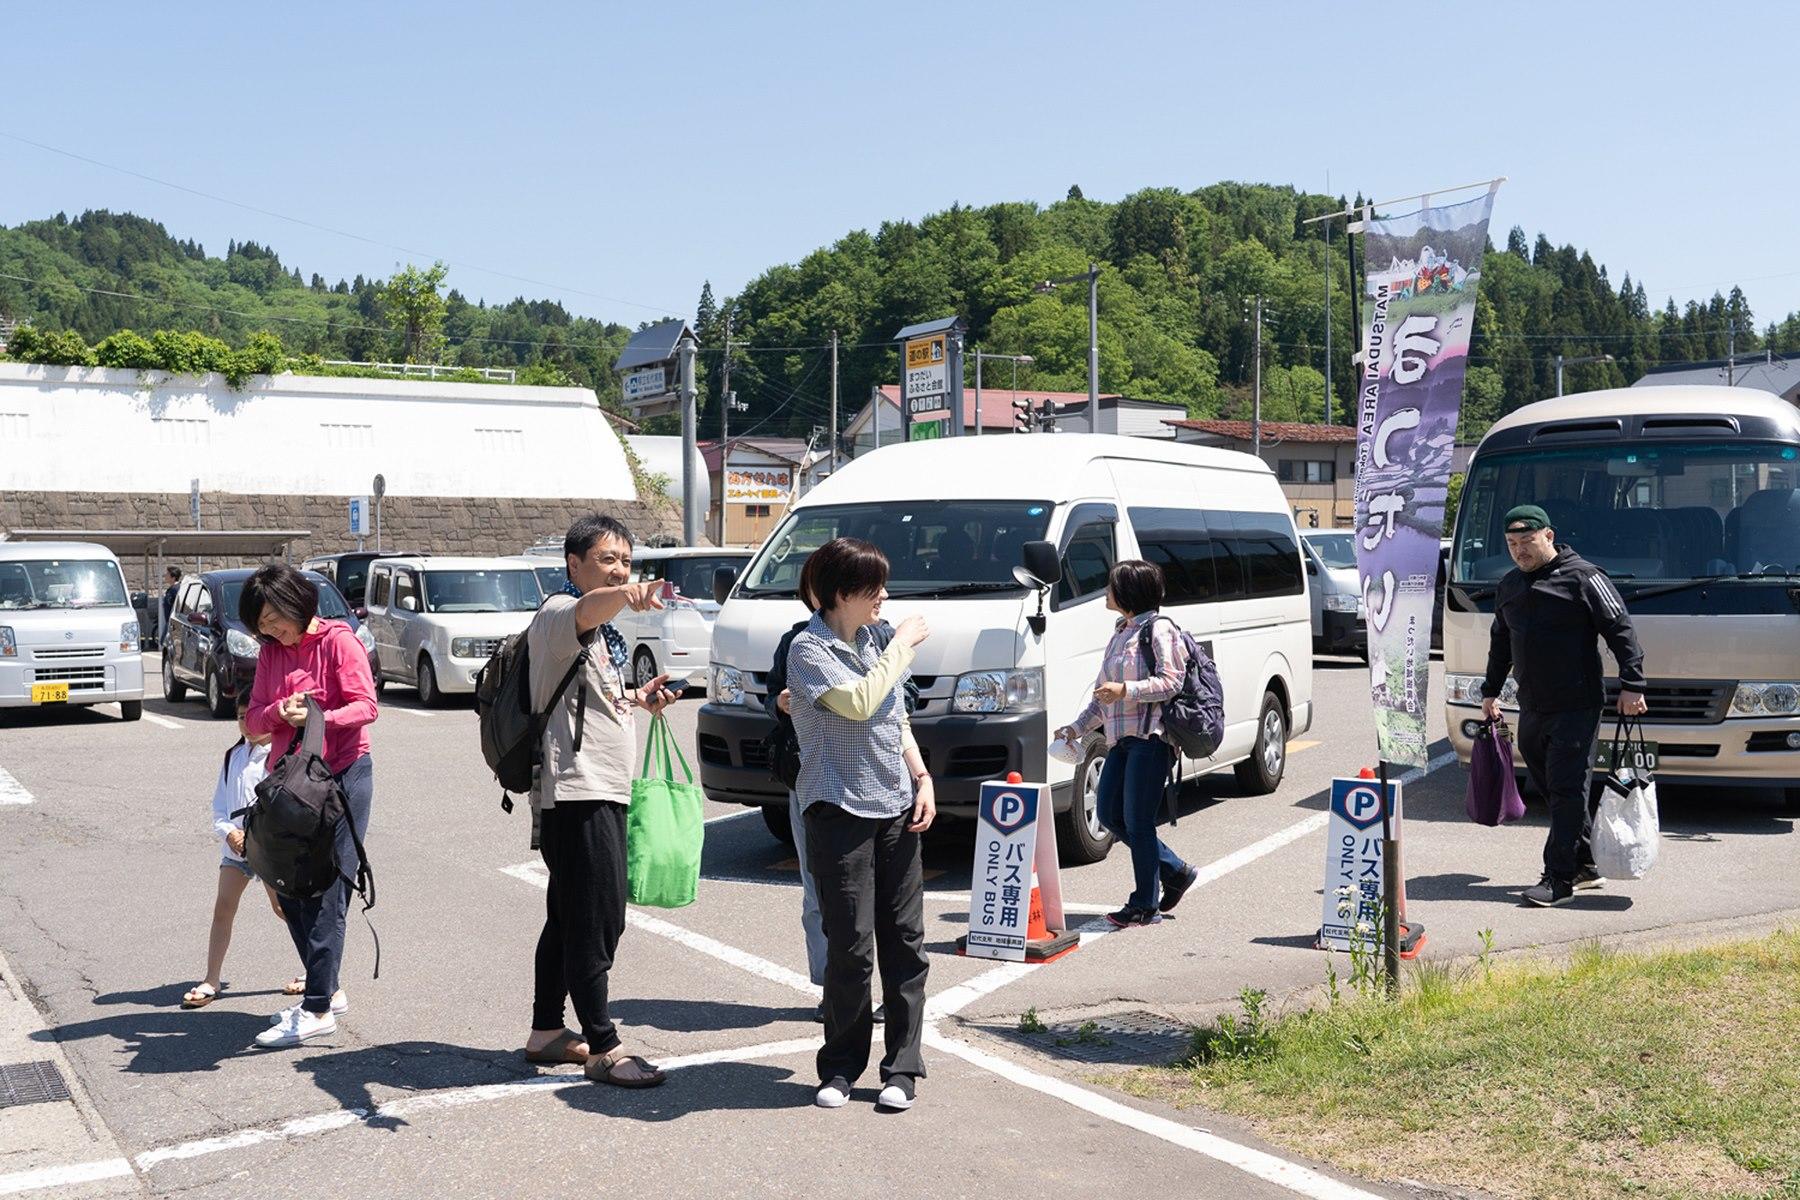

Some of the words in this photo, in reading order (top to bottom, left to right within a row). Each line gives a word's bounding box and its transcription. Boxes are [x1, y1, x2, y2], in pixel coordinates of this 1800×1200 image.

[909, 370, 932, 383] まつだい
[909, 379, 943, 394] ふるさと会館
[1000, 797, 1019, 822] P
[1354, 791, 1375, 816] P
[986, 840, 1001, 886] ONLY
[1340, 834, 1355, 880] ONLY
[1000, 842, 1026, 928] バス専用
[982, 891, 996, 925] BUS
